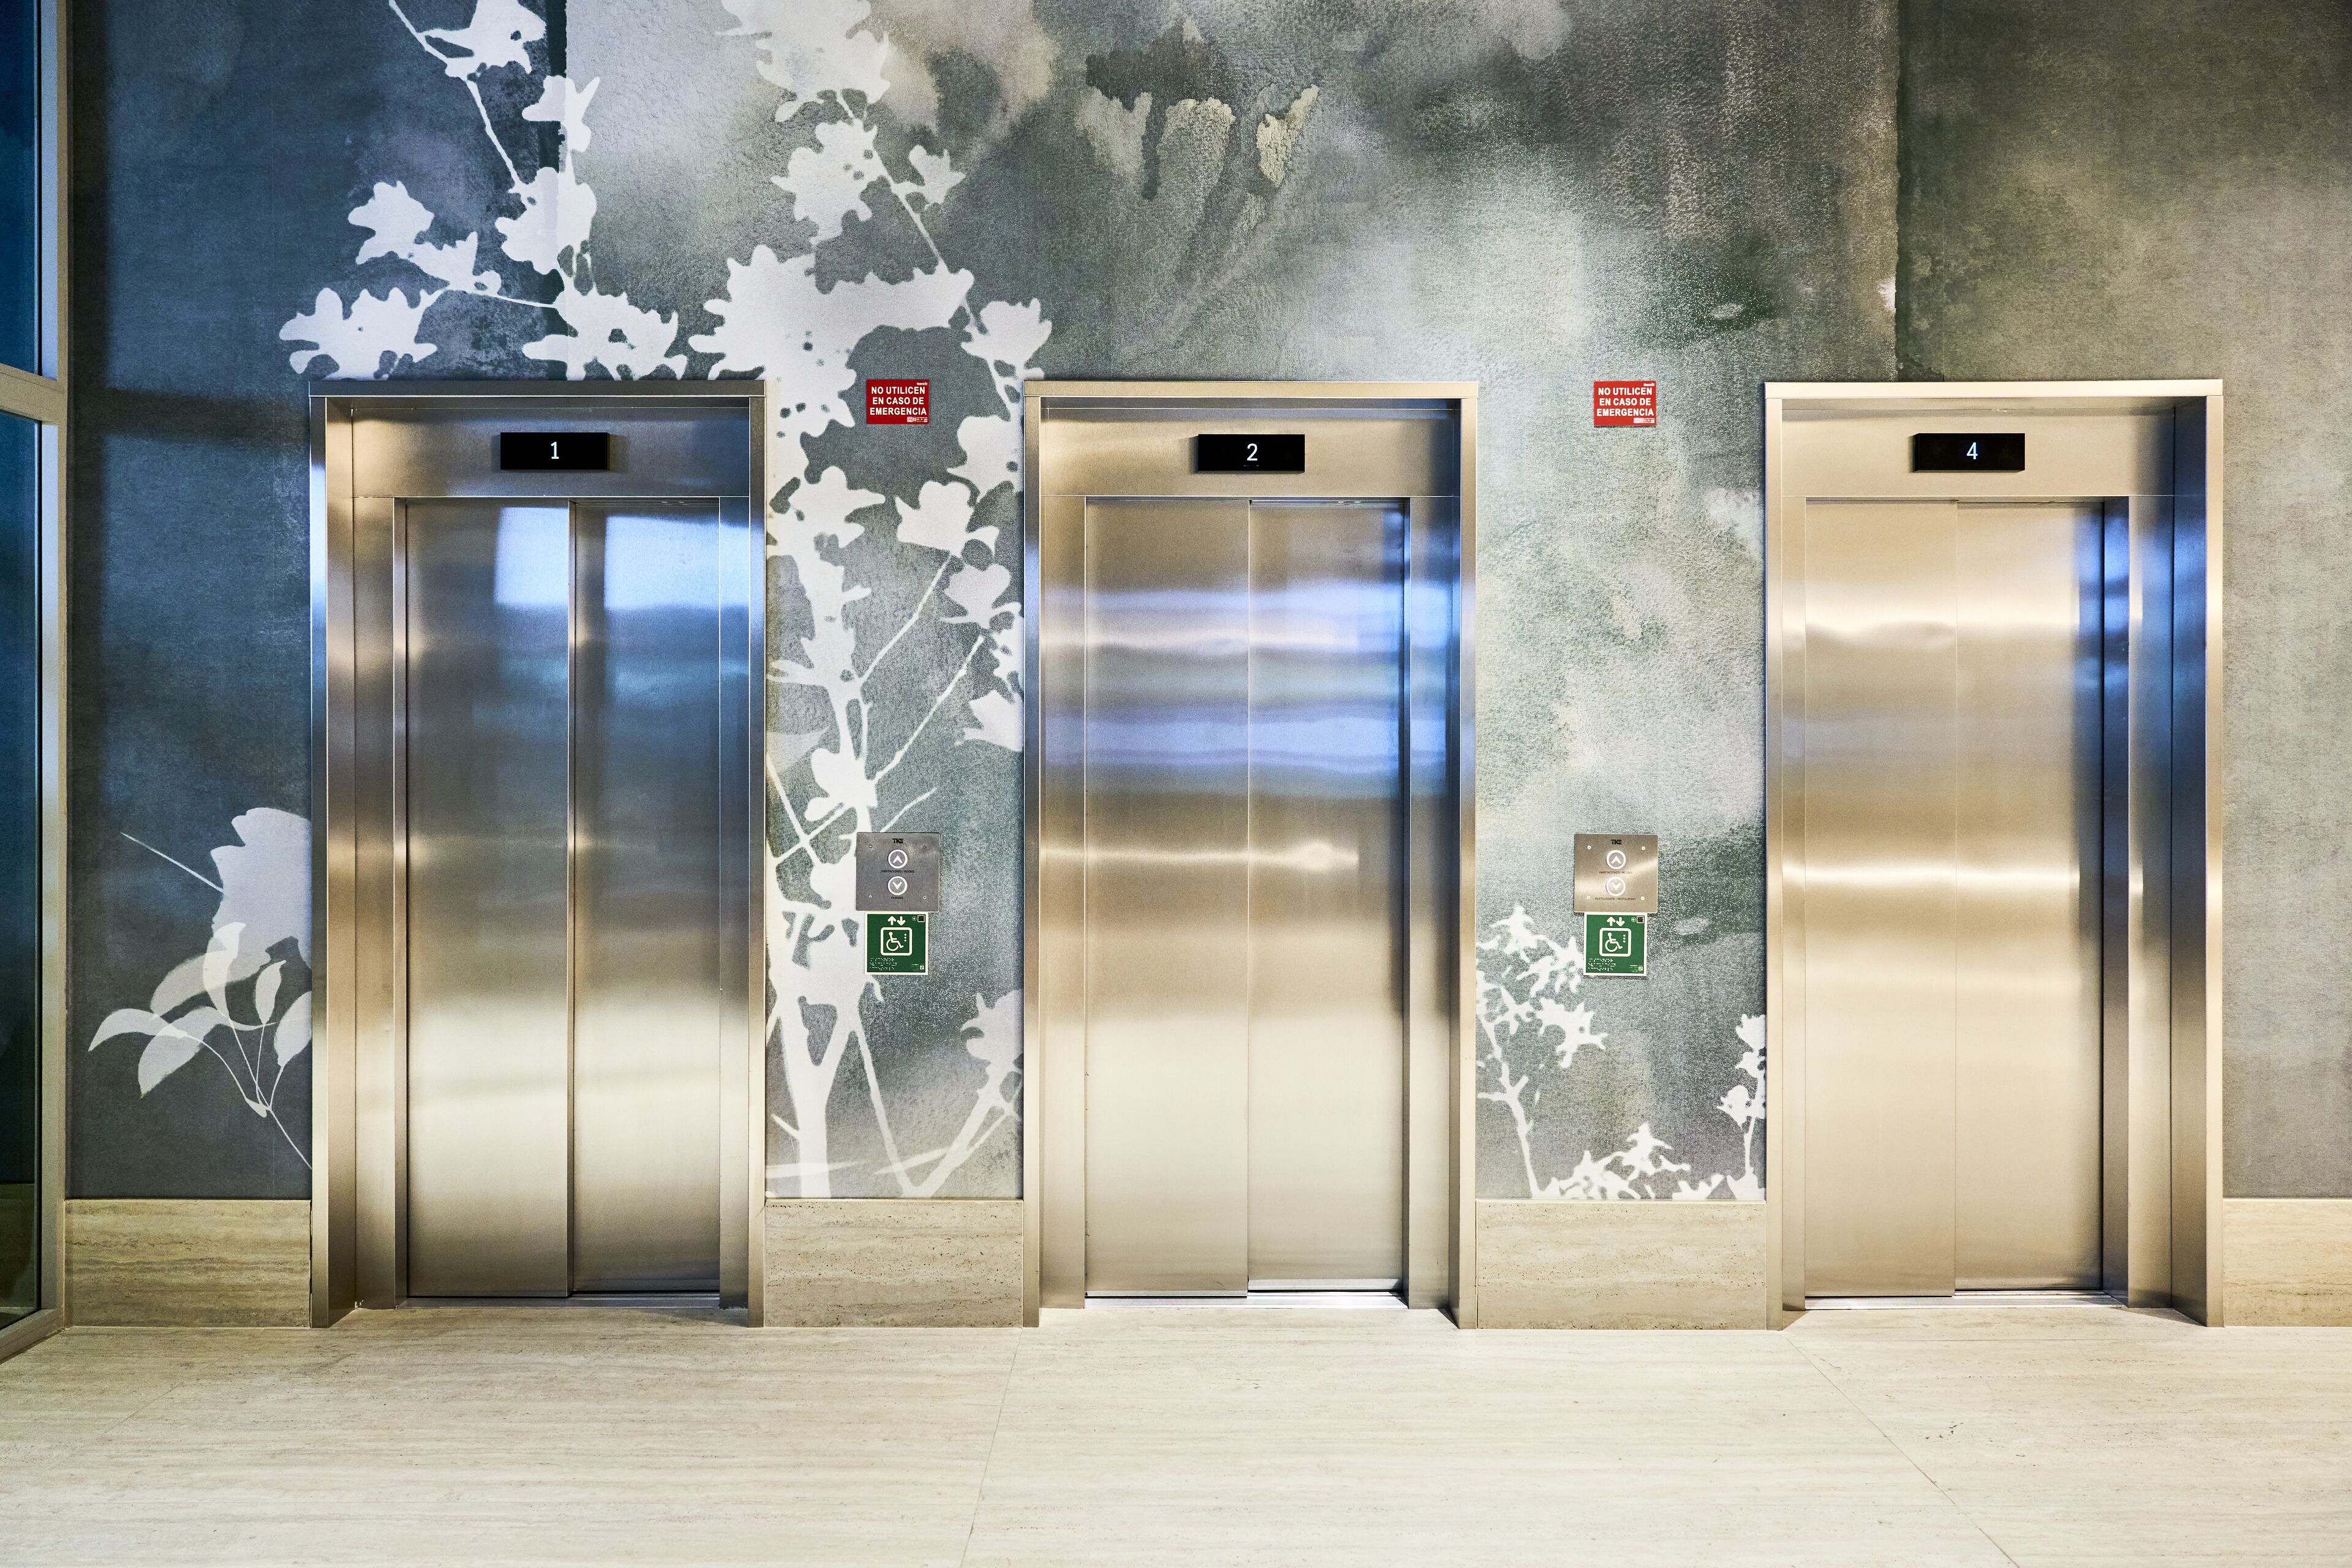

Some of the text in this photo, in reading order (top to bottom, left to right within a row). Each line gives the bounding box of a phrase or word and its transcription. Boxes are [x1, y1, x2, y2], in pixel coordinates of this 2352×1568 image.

[1598, 387, 1653, 396] NO UTILICEN
[1599, 398, 1651, 406] EN CASO DE
[1597, 408, 1654, 417] EMERGENCIA
[551, 441, 559, 459] 1
[1246, 443, 1258, 461] 2
[1966, 442, 1978, 460] 4
